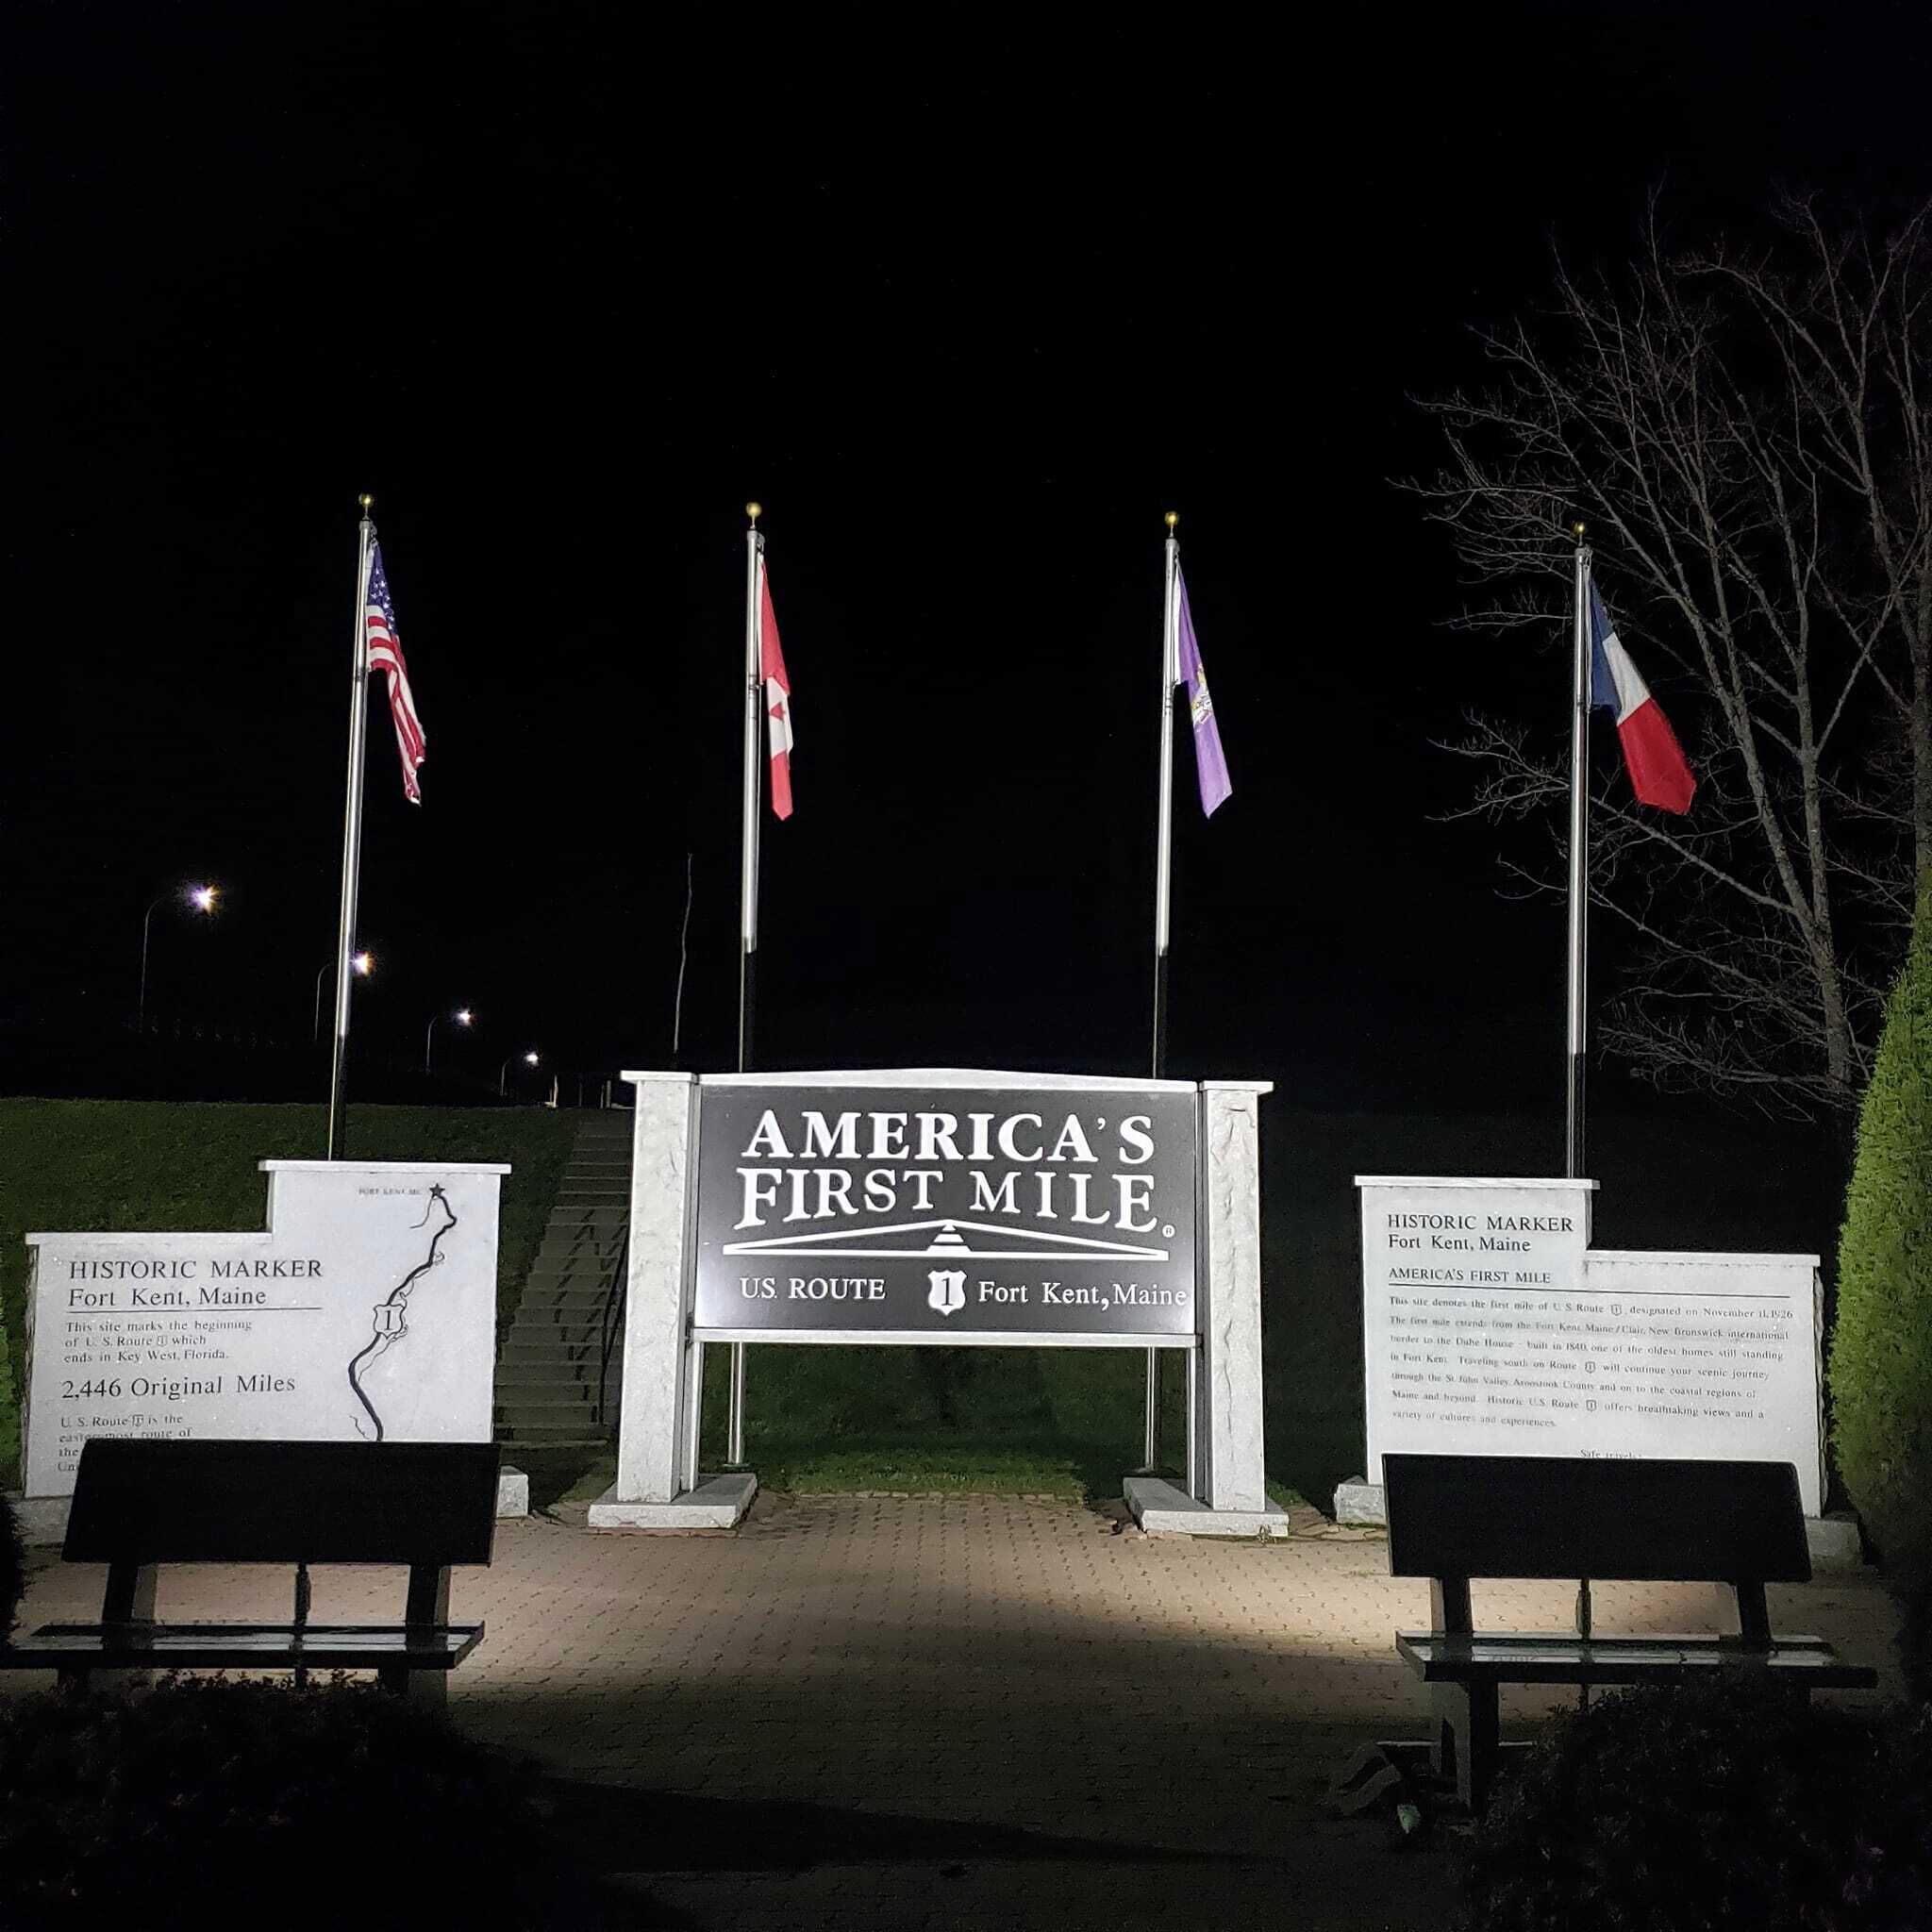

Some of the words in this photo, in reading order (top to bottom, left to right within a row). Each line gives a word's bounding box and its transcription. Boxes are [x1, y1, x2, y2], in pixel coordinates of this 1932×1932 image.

[740, 1108, 1156, 1164] AMERICA'S
[733, 1166, 944, 1231] FIRST
[969, 1170, 1159, 1234] MILE
[1388, 1214, 1476, 1230] HISTORIC
[1487, 1215, 1574, 1232] MARKER
[1388, 1234, 1421, 1249] Fort
[1431, 1235, 1474, 1251] Kent,
[1479, 1237, 1531, 1252] Maine
[69, 1260, 197, 1280] HISTORIC
[210, 1259, 323, 1278] MARKER
[1388, 1267, 1464, 1281] AMERICA'S
[1470, 1270, 1509, 1283] FIRST
[1515, 1272, 1551, 1284] MILE
[68, 1289, 116, 1307] Fort
[131, 1287, 190, 1307] Kent,
[198, 1287, 267, 1306] Maine
[788, 1277, 886, 1300] ROUTE
[978, 1282, 1029, 1304] Fort
[1041, 1283, 1111, 1309] Kent,
[1112, 1284, 1188, 1307] Maine
[1390, 1296, 1408, 1306] This
[1412, 1297, 1429, 1307] site
[1432, 1298, 1467, 1307] denotes
[1472, 1299, 1486, 1309] the
[1491, 1300, 1509, 1309] first
[1513, 1301, 1534, 1310] mile
[1538, 1302, 1548, 1311] of
[1576, 1303, 1605, 1313] Route
[1630, 1305, 1681, 1319] designated
[1686, 1307, 1698, 1316] on
[1703, 1307, 1754, 1318] November
[66, 1322, 92, 1333] This
[98, 1321, 121, 1332] site
[126, 1322, 162, 1332] marks
[169, 1321, 189, 1331] the
[194, 1320, 253, 1333] beginning
[1390, 1316, 1406, 1325] The
[1410, 1317, 1427, 1326] first
[1432, 1318, 1451, 1326] mile
[1491, 1320, 1513, 1329] from
[1517, 1321, 1532, 1330] the
[1648, 1325, 1669, 1336] New
[1674, 1326, 1724, 1338] Brunswick
[1727, 1328, 1790, 1340] international
[64, 1336, 80, 1347] of
[117, 1336, 152, 1347] Route
[172, 1336, 206, 1346] which
[1390, 1335, 1419, 1344] border
[1424, 1336, 1433, 1344] to
[1437, 1337, 1452, 1346] the
[1484, 1339, 1514, 1349] House
[1591, 1344, 1608, 1353] one
[1613, 1344, 1623, 1354] of
[1628, 1344, 1644, 1355] the
[1647, 1345, 1676, 1356] oldest
[1681, 1346, 1714, 1357] homes
[1719, 1349, 1737, 1358] still
[1742, 1350, 1783, 1362] standing
[63, 1352, 92, 1363] ends
[99, 1352, 111, 1362] in
[118, 1351, 141, 1364] Key
[183, 1349, 229, 1361] Florida.
[1403, 1353, 1422, 1363] Fort
[1457, 1356, 1499, 1368] Traveling
[1504, 1358, 1528, 1368] south
[1550, 1359, 1577, 1371] Route
[1603, 1363, 1620, 1373] will
[1624, 1364, 1666, 1375] continue
[1671, 1367, 1691, 1377] your
[1697, 1367, 1728, 1378] scenic
[1732, 1369, 1770, 1381] journey
[60, 1378, 122, 1400] 2,446
[130, 1375, 223, 1401] Original
[236, 1374, 296, 1392] Miles
[1391, 1373, 1424, 1383] through
[1427, 1374, 1442, 1383] the
[1458, 1374, 1479, 1385] John
[1512, 1378, 1559, 1389] Aroostook
[1599, 1383, 1616, 1391] and
[1636, 1385, 1646, 1393] to
[1650, 1385, 1665, 1395] the
[1670, 1387, 1702, 1396] coastal
[1707, 1389, 1741, 1400] regions
[1746, 1390, 1757, 1399] of
[1392, 1389, 1419, 1400] Maine
[1423, 1391, 1439, 1401] and
[1488, 1395, 1524, 1407] Historic
[1551, 1399, 1579, 1409] Route
[1604, 1402, 1633, 1412] offers
[1638, 1404, 1699, 1417] breathtaking
[1703, 1407, 1731, 1418] views
[1735, 1409, 1754, 1419] and
[92, 1415, 128, 1426] Route
[147, 1415, 158, 1425] is
[163, 1414, 183, 1424] the
[1392, 1411, 1422, 1421] variety
[1425, 1410, 1436, 1420] of
[1440, 1412, 1476, 1423] cultures
[1480, 1414, 1496, 1424] and
[179, 1427, 193, 1438] of
[58, 1447, 79, 1457] the
